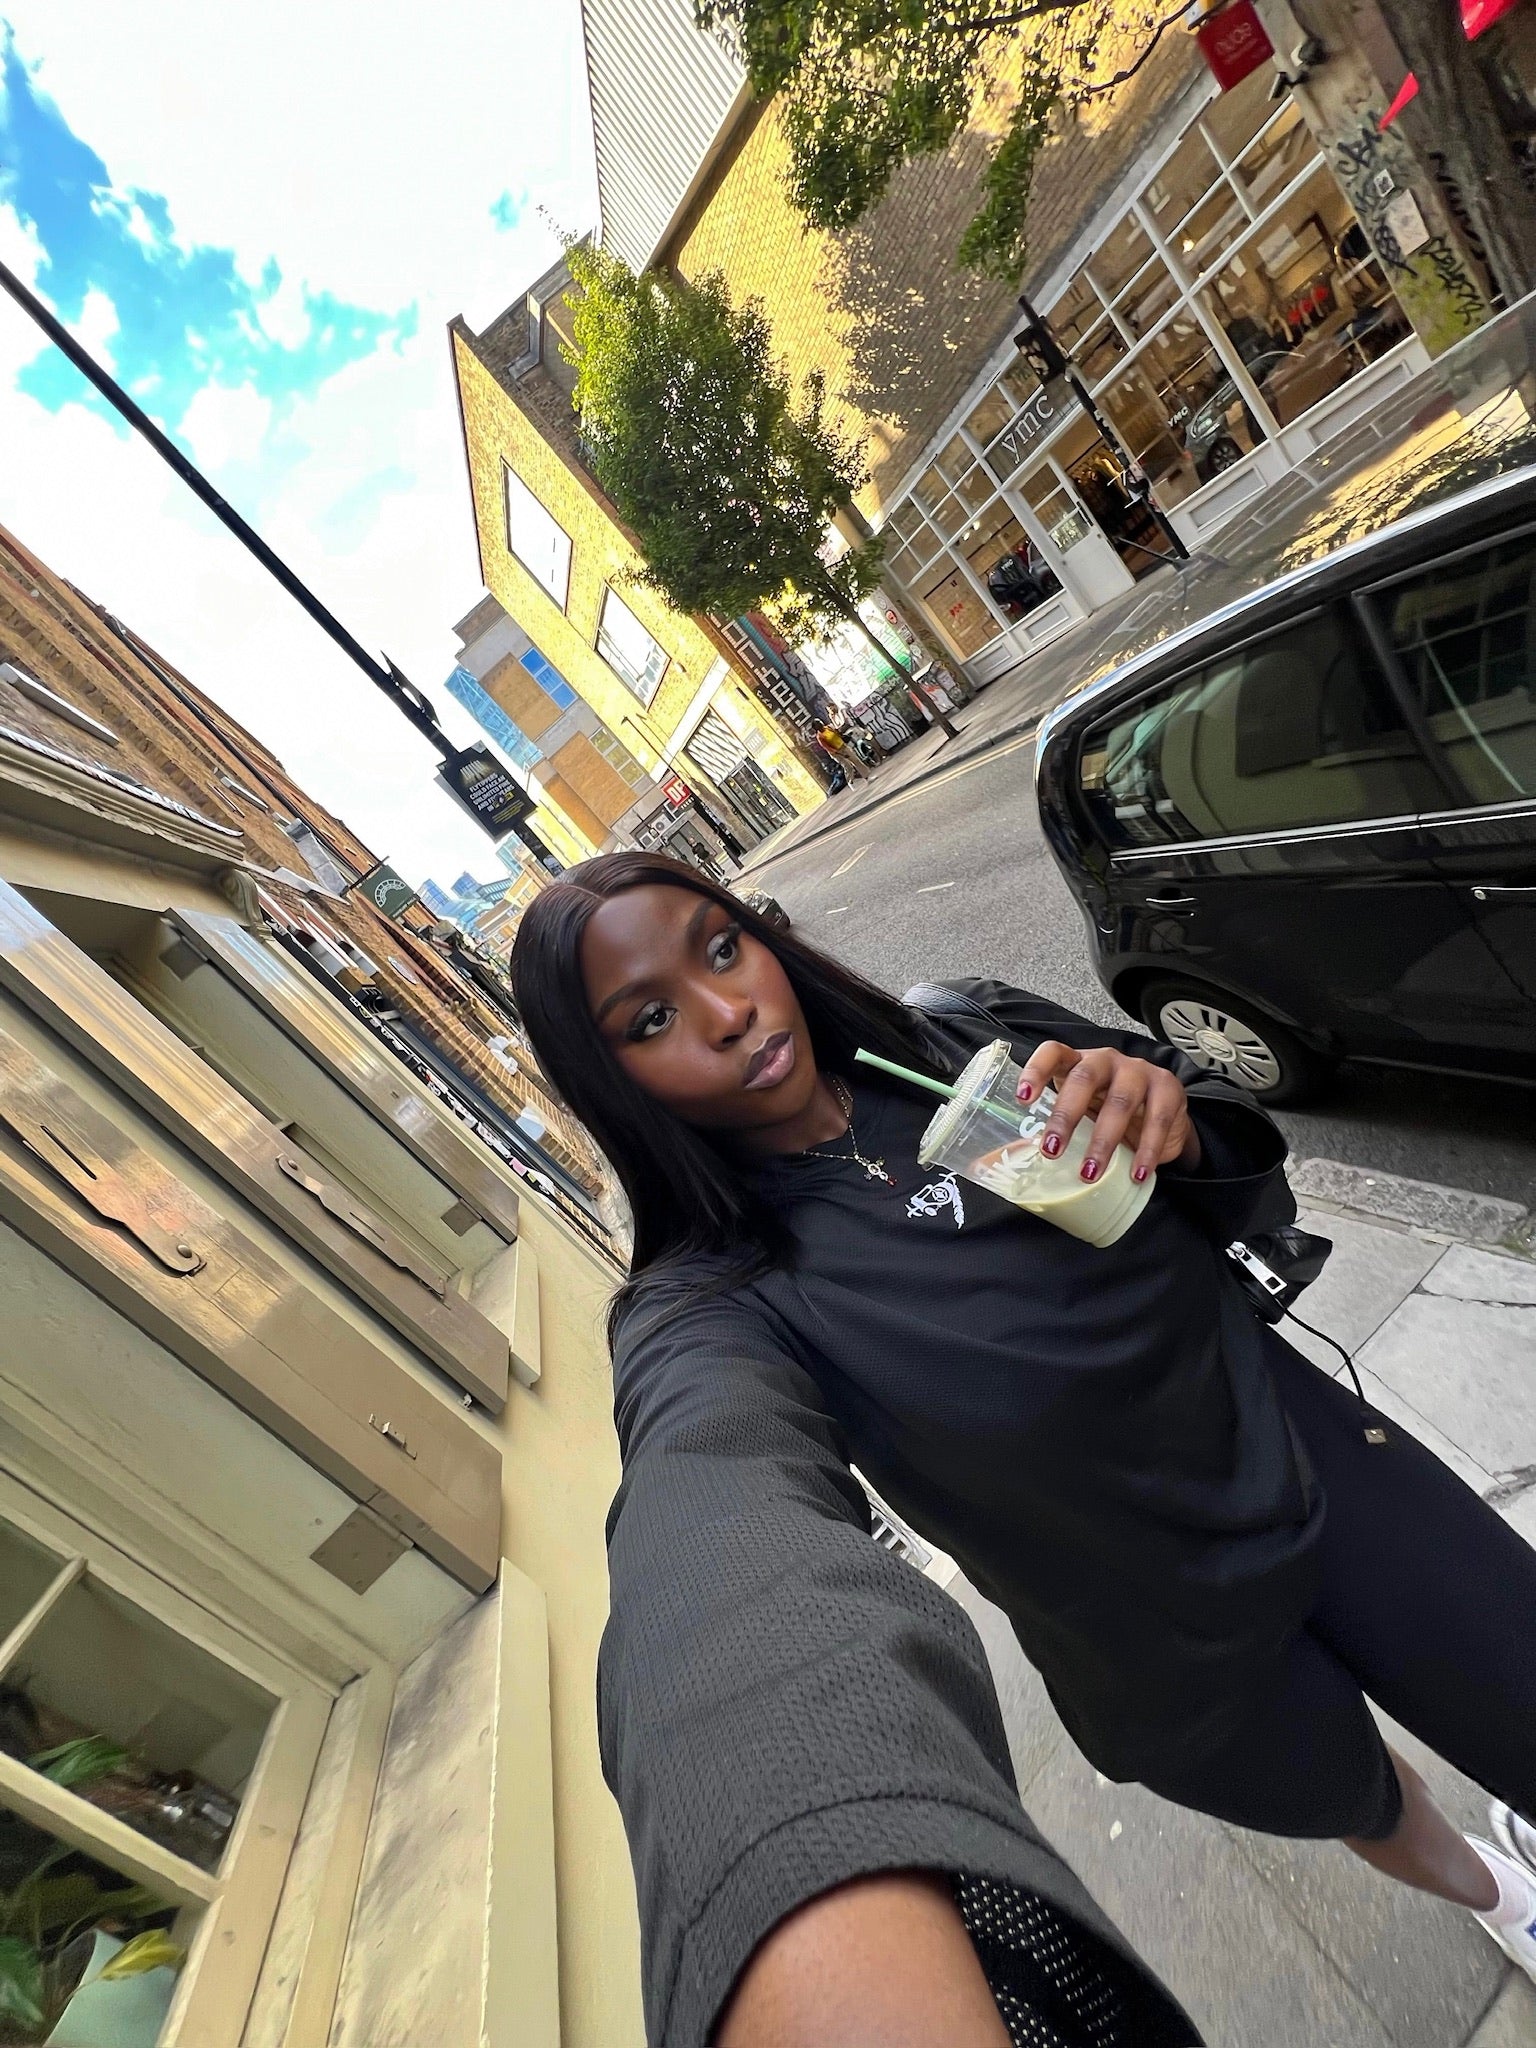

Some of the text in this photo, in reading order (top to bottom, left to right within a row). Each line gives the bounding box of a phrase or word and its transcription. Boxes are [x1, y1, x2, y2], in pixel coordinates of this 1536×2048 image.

[1167, 405, 1189, 427] YMC
[1001, 395, 1054, 464] ymc
[469, 786, 488, 800] COULD
[485, 779, 499, 791] FACE
[472, 785, 500, 806] UNLIMITED
[477, 800, 489, 811] AND
